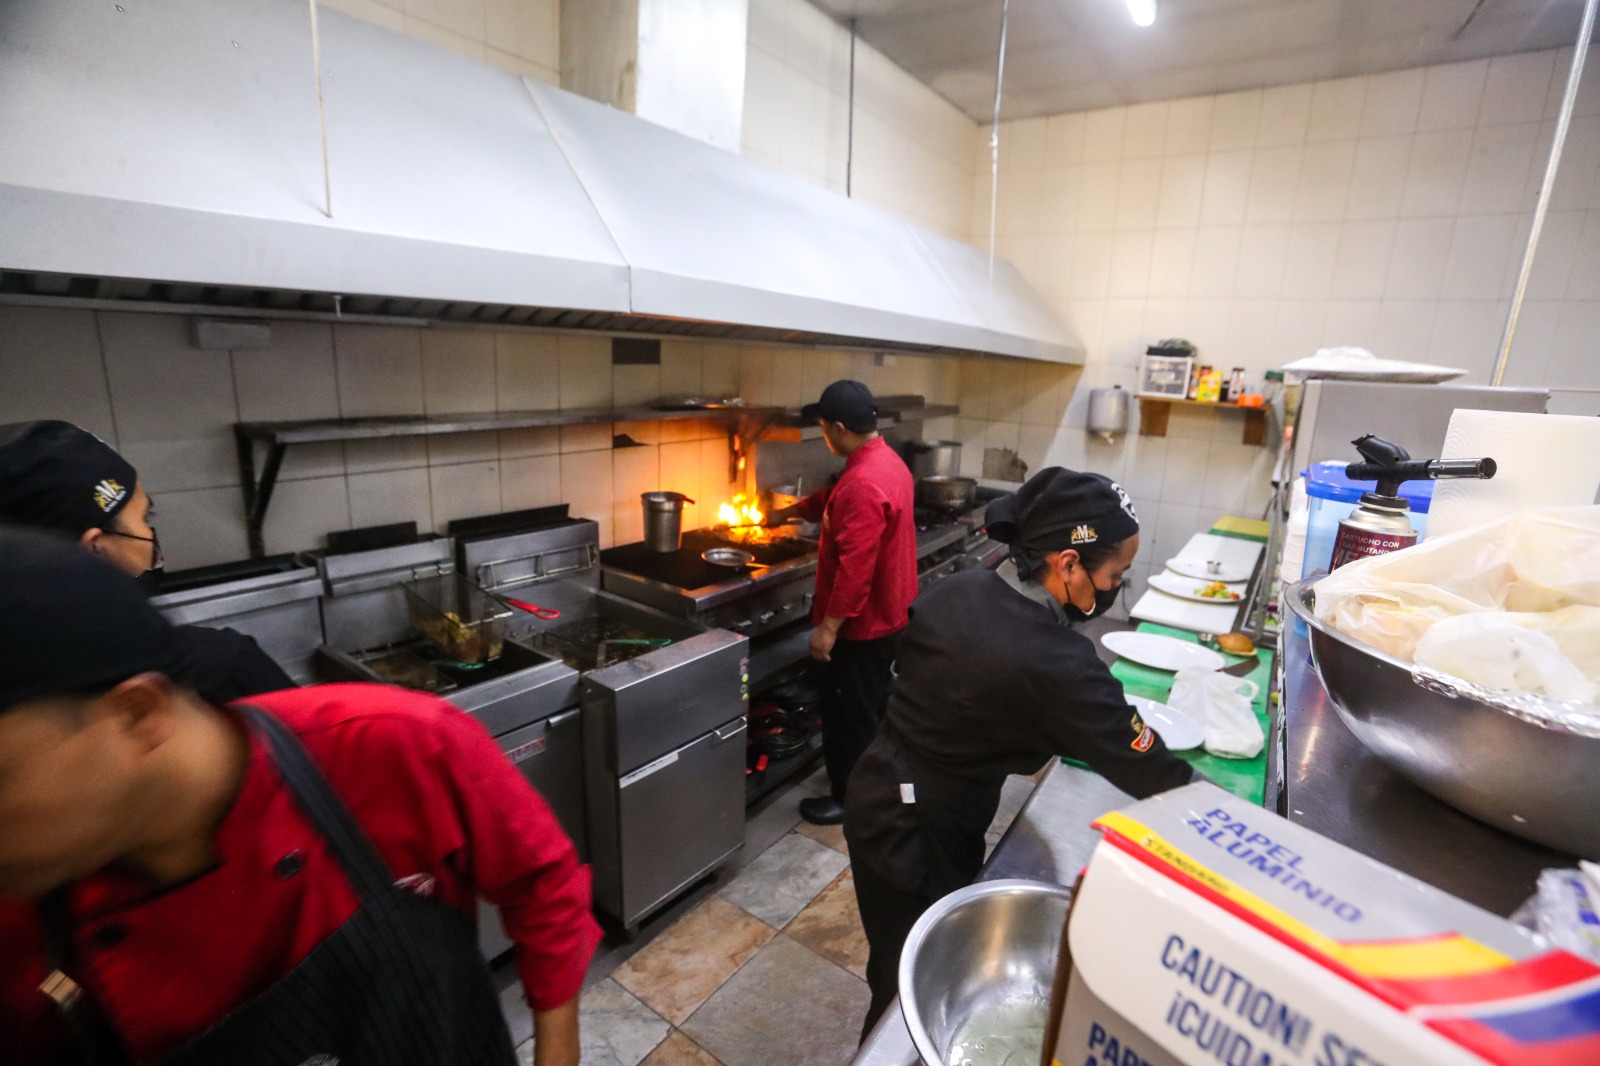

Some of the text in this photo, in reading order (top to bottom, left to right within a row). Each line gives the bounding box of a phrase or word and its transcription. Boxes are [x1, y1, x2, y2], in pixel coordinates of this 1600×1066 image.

[1382, 540, 1400, 549] CON
[1187, 818, 1363, 923] ALUMINIO
[1205, 808, 1305, 873] PAPEL
